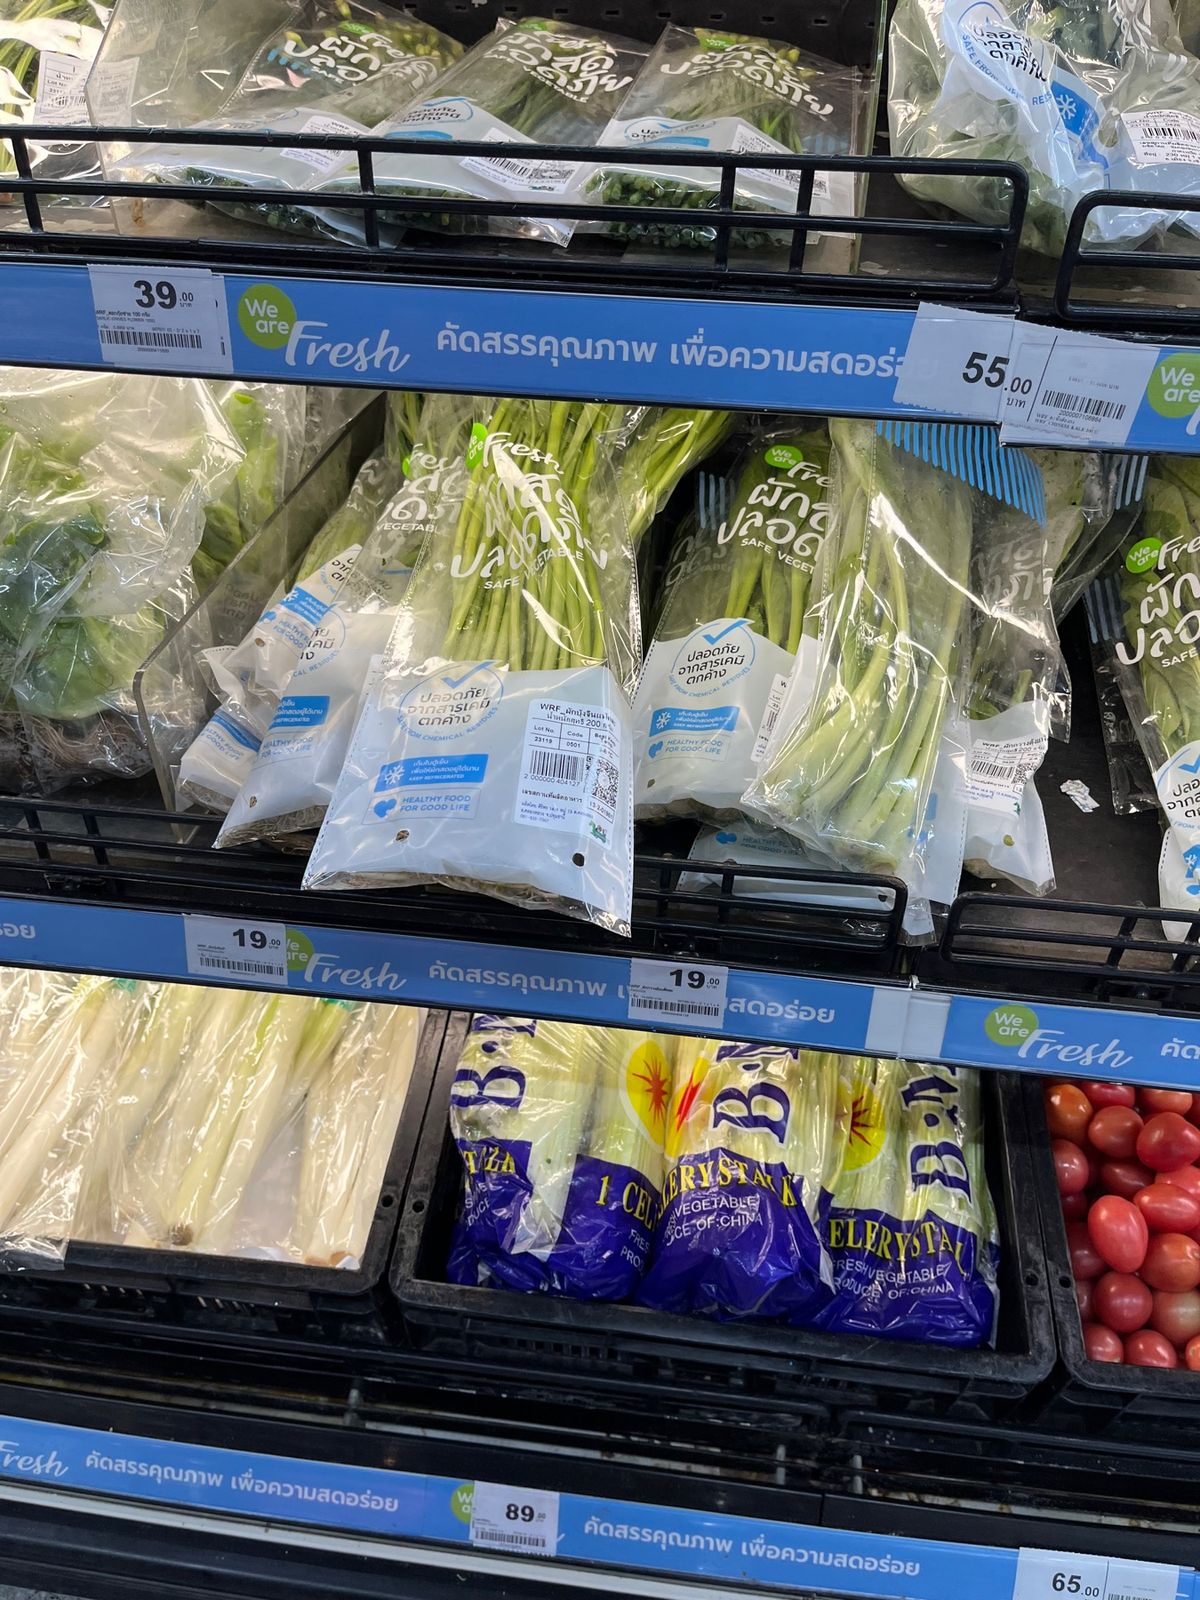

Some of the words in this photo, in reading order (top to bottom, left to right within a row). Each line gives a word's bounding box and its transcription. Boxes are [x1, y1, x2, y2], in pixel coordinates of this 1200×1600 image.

[962, 33, 977, 60] SAFE
[245, 299, 278, 318] We
[256, 319, 289, 334] are
[285, 320, 411, 372] Fresh
[437, 321, 658, 367] คัดสรรคุณภาพ
[670, 328, 905, 378] เพื่อความสดอร่
[1160, 366, 1195, 387] We
[1006, 396, 1026, 409] บาท
[1164, 388, 1200, 403] are
[771, 449, 792, 457] We
[774, 456, 797, 464] are
[788, 461, 834, 488] Fre
[748, 477, 836, 532] ผักส
[717, 507, 825, 562] ปลอด
[741, 538, 772, 554] SAFE
[778, 551, 815, 575] VEGET
[1129, 547, 1150, 561] We
[1137, 550, 1158, 566] are
[1158, 535, 1200, 570] Fre
[484, 576, 520, 590] SAFE
[1140, 572, 1200, 625] ผัก
[1115, 609, 1200, 665] ปลอ
[687, 643, 741, 662] ปลอดภัย
[1162, 648, 1198, 667] SAFE
[678, 655, 746, 675] จากสารเคมี
[686, 669, 726, 685] ตกค้าง
[420, 687, 487, 703] ปลอดภัย
[688, 687, 720, 697] CHEMICAL
[407, 697, 491, 715] จากสารเคมี
[418, 712, 472, 726] ตกค้าง
[586, 719, 600, 728] 200
[422, 732, 464, 742] CHEMICAL
[567, 730, 583, 738] Code
[701, 739, 723, 747] FOOD
[665, 745, 679, 753] FOR
[705, 747, 721, 755] LIFE
[1173, 778, 1200, 797] ปลอ
[401, 804, 419, 812] FOR
[420, 803, 448, 812] GOOD
[450, 803, 470, 811] LIFE
[403, 794, 442, 804] HEALTHY
[444, 794, 471, 803] FOOD
[287, 939, 300, 950] e
[304, 953, 407, 991] Fresh
[428, 960, 606, 996] คัดสรรคุณภาพ
[994, 1011, 1023, 1027] We
[999, 1025, 1029, 1037] are
[1017, 1029, 1133, 1068] Fresh
[1160, 1037, 1200, 1060] คัด
[595, 1175, 611, 1207] 1
[622, 1181, 656, 1232] CEL
[675, 1196, 758, 1216] VEGETABLE
[629, 1229, 651, 1254] FRES
[829, 1218, 970, 1276] ELERYSTAL
[833, 1276, 881, 1298] RODUCE
[86, 1450, 223, 1485] คัดสรรคุณภาพ
[231, 1468, 399, 1512] เพื่อความสดอร่อย
[457, 1490, 472, 1503] W
[584, 1515, 733, 1552] คัดสรรคุณภาพ
[741, 1533, 920, 1577] เพื่อความสดอร่อย
[1052, 1572, 1099, 1597] 65.00
